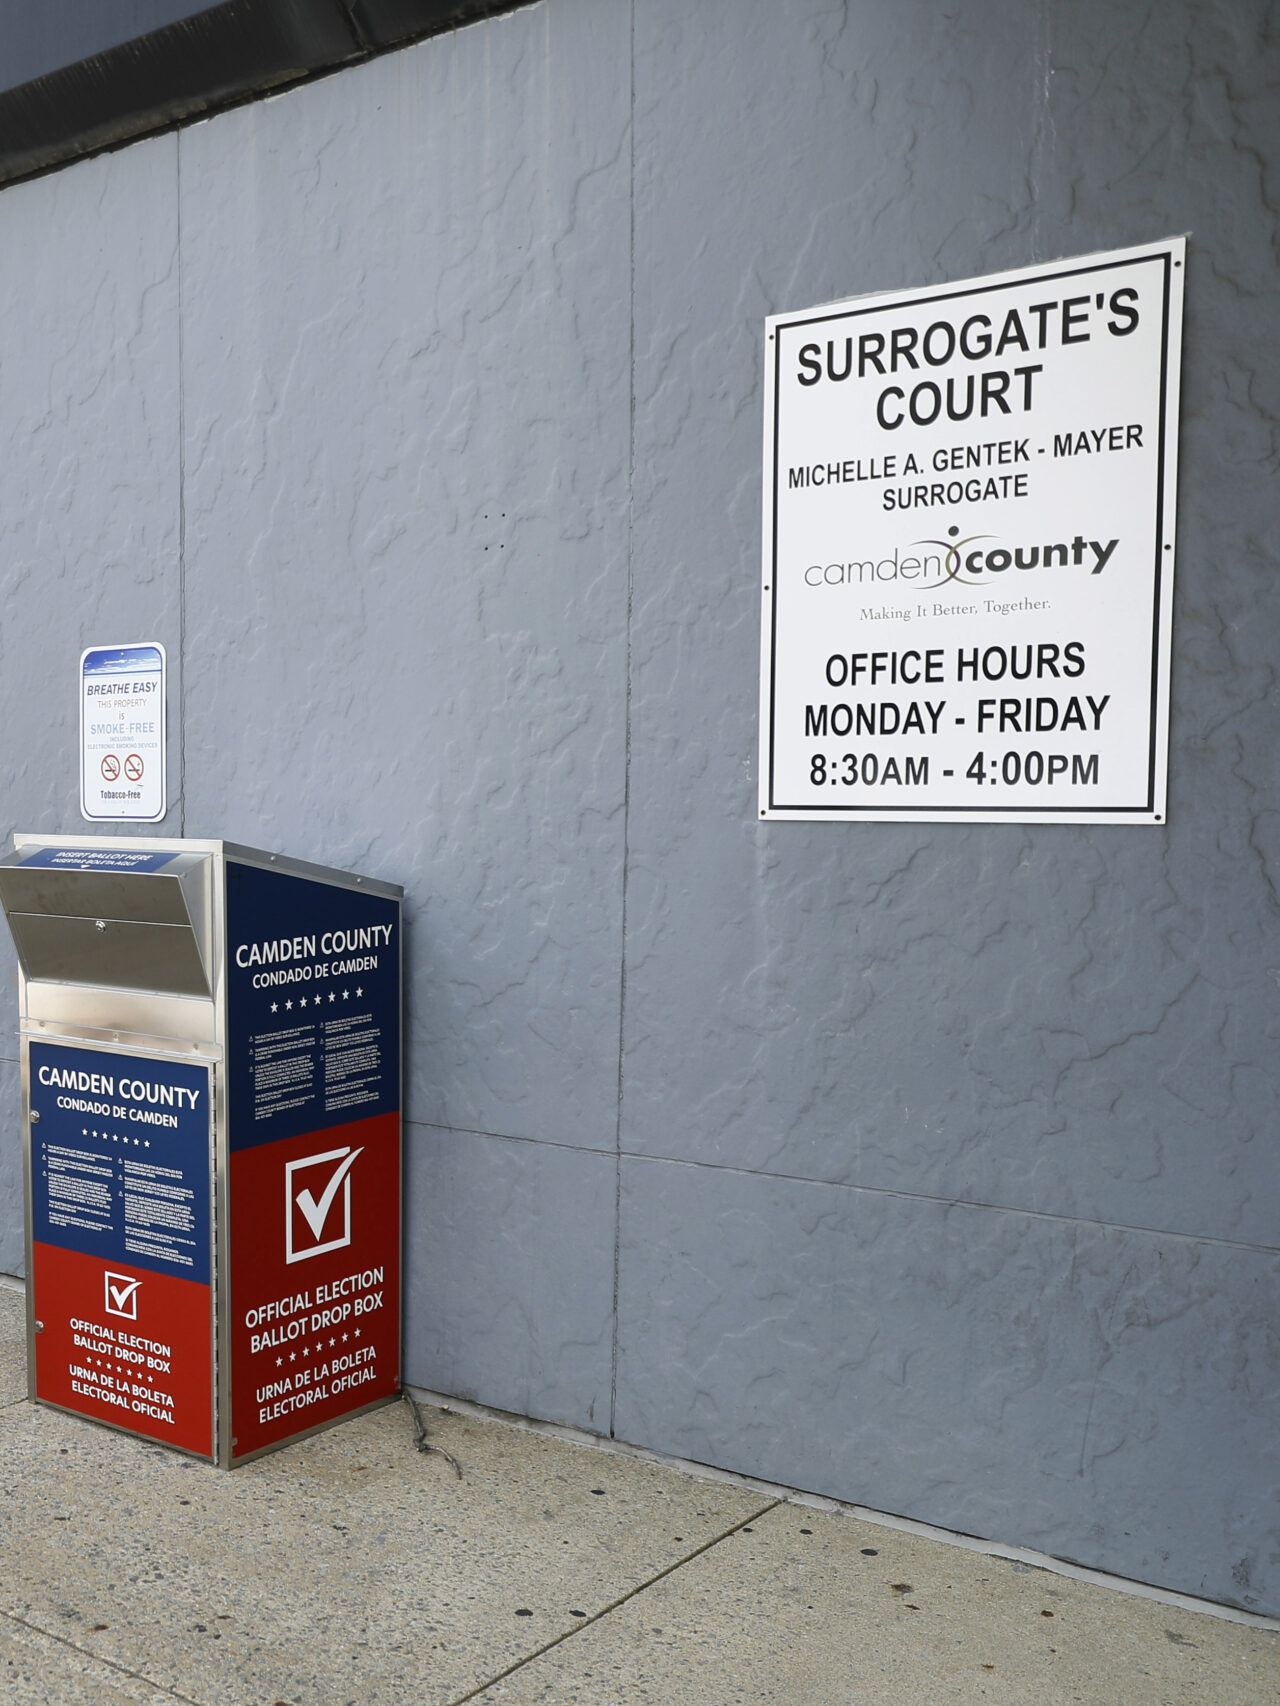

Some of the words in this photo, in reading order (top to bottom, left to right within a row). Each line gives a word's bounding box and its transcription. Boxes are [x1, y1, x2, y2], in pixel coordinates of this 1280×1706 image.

[797, 287, 1140, 387] SURROGATE'S
[876, 364, 1043, 431] COURT
[788, 454, 897, 489] MICHELLE
[904, 452, 925, 477] A.
[932, 438, 1030, 472] GENTEK
[1053, 424, 1144, 458] MAYER
[882, 473, 1029, 511] SURROGATE
[804, 547, 941, 587] camden
[965, 536, 1120, 575] county
[859, 608, 911, 621] Making
[917, 605, 927, 617] It
[932, 603, 978, 617] Better,
[984, 597, 1051, 615] Together.
[825, 649, 945, 687] OFFICE
[957, 641, 1086, 682] HOURS
[87, 683, 130, 696] BREATHE
[132, 682, 158, 693] EASY
[97, 700, 112, 708] THIS
[114, 699, 147, 708] PROPERTY
[804, 700, 947, 737] MONDAY
[977, 694, 1111, 733] FRIDAY
[809, 753, 929, 787] 8:30AM
[966, 750, 1100, 786] 4:00PM
[236, 935, 316, 968] CAMDEN
[321, 923, 393, 955] COUNTY
[252, 965, 312, 989] CONDADO
[315, 963, 329, 979] DE
[331, 955, 378, 976] CAMDEN
[38, 1065, 114, 1096] CAMDEN
[119, 1078, 200, 1110] COUNTY
[56, 1095, 111, 1116] CONDADO
[113, 1106, 127, 1119] DE
[129, 1108, 178, 1129] CAMDEN
[245, 1291, 313, 1328] OFFICIAL
[316, 1266, 384, 1304] ELECTION
[70, 1317, 116, 1342] OFFICIAL
[118, 1331, 171, 1358] ELECTION
[250, 1317, 308, 1354] BALLOT
[311, 1302, 352, 1332] DROP
[354, 1291, 384, 1317] BOX
[73, 1334, 113, 1356] BALLOT
[115, 1346, 145, 1365] DROP
[147, 1357, 171, 1374] BOX
[256, 1377, 293, 1403] URNA
[295, 1370, 311, 1388] DE
[314, 1363, 329, 1382] LA
[331, 1345, 377, 1375] BOLETA
[69, 1363, 99, 1384] URNA
[100, 1373, 114, 1388] DE
[116, 1379, 130, 1394] LA
[132, 1384, 175, 1408] BOLETA
[72, 1379, 130, 1409] ELECTORAL
[131, 1400, 176, 1424] OFICIAL
[259, 1385, 329, 1424] ELECTORAL
[331, 1365, 377, 1395] OFICIAL
